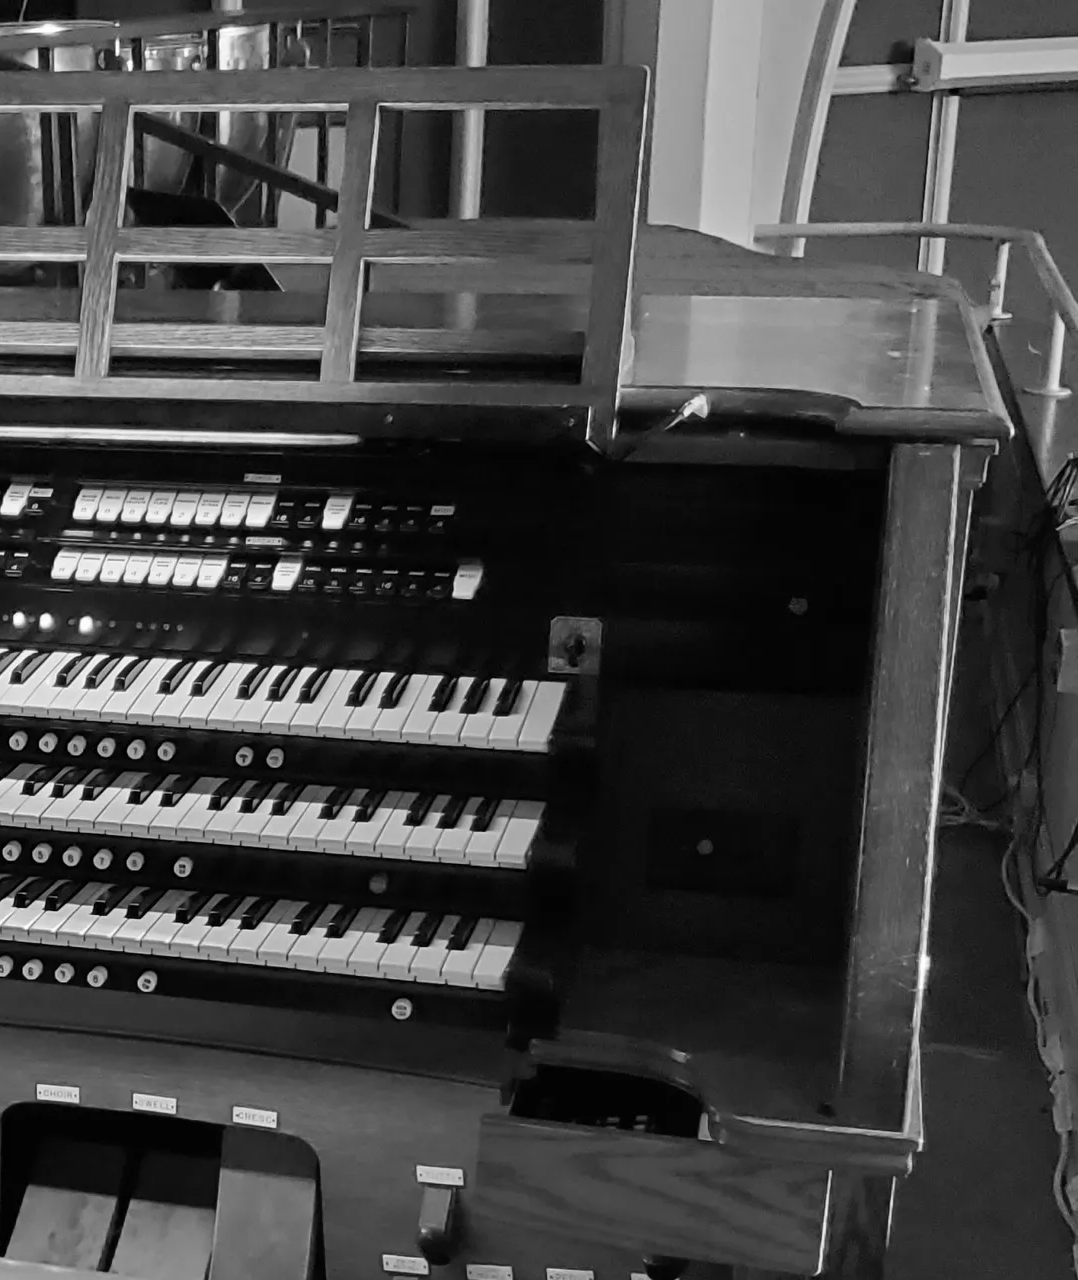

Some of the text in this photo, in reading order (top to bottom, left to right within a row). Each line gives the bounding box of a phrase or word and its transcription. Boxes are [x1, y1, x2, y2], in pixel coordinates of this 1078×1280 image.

[43, 740, 49, 749] 4
[133, 747, 139, 755] 7
[7, 849, 13, 857] 4
[99, 857, 105, 866] 7
[43, 1089, 73, 1099] CHOIR
[138, 1098, 172, 1110] SWELL
